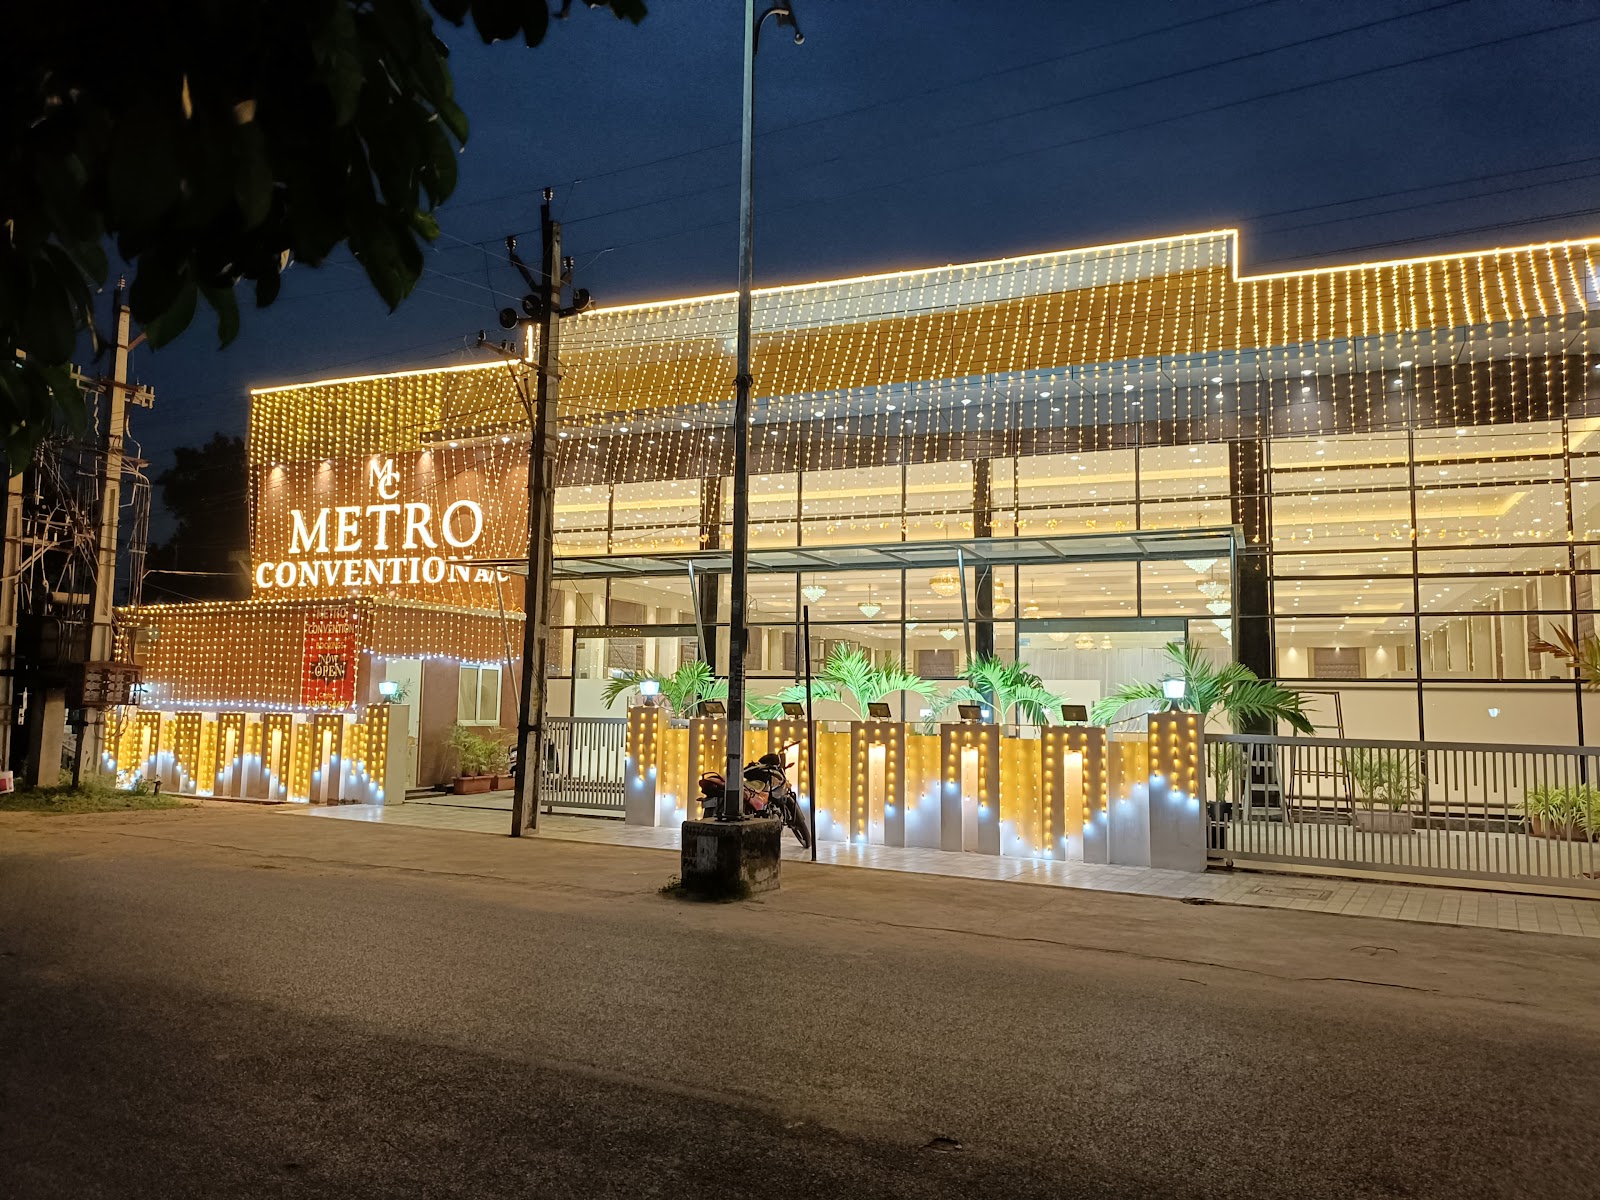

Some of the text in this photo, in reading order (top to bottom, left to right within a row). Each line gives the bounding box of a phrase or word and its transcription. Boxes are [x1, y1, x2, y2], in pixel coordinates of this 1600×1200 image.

[288, 500, 483, 554] METRO
[256, 555, 473, 588] CONVENTION
[316, 607, 346, 619] METRO
[308, 623, 354, 634] CONVENTION
[316, 642, 344, 650] BOOKINGS
[320, 654, 339, 664] NOW
[315, 665, 343, 677] OPEN
